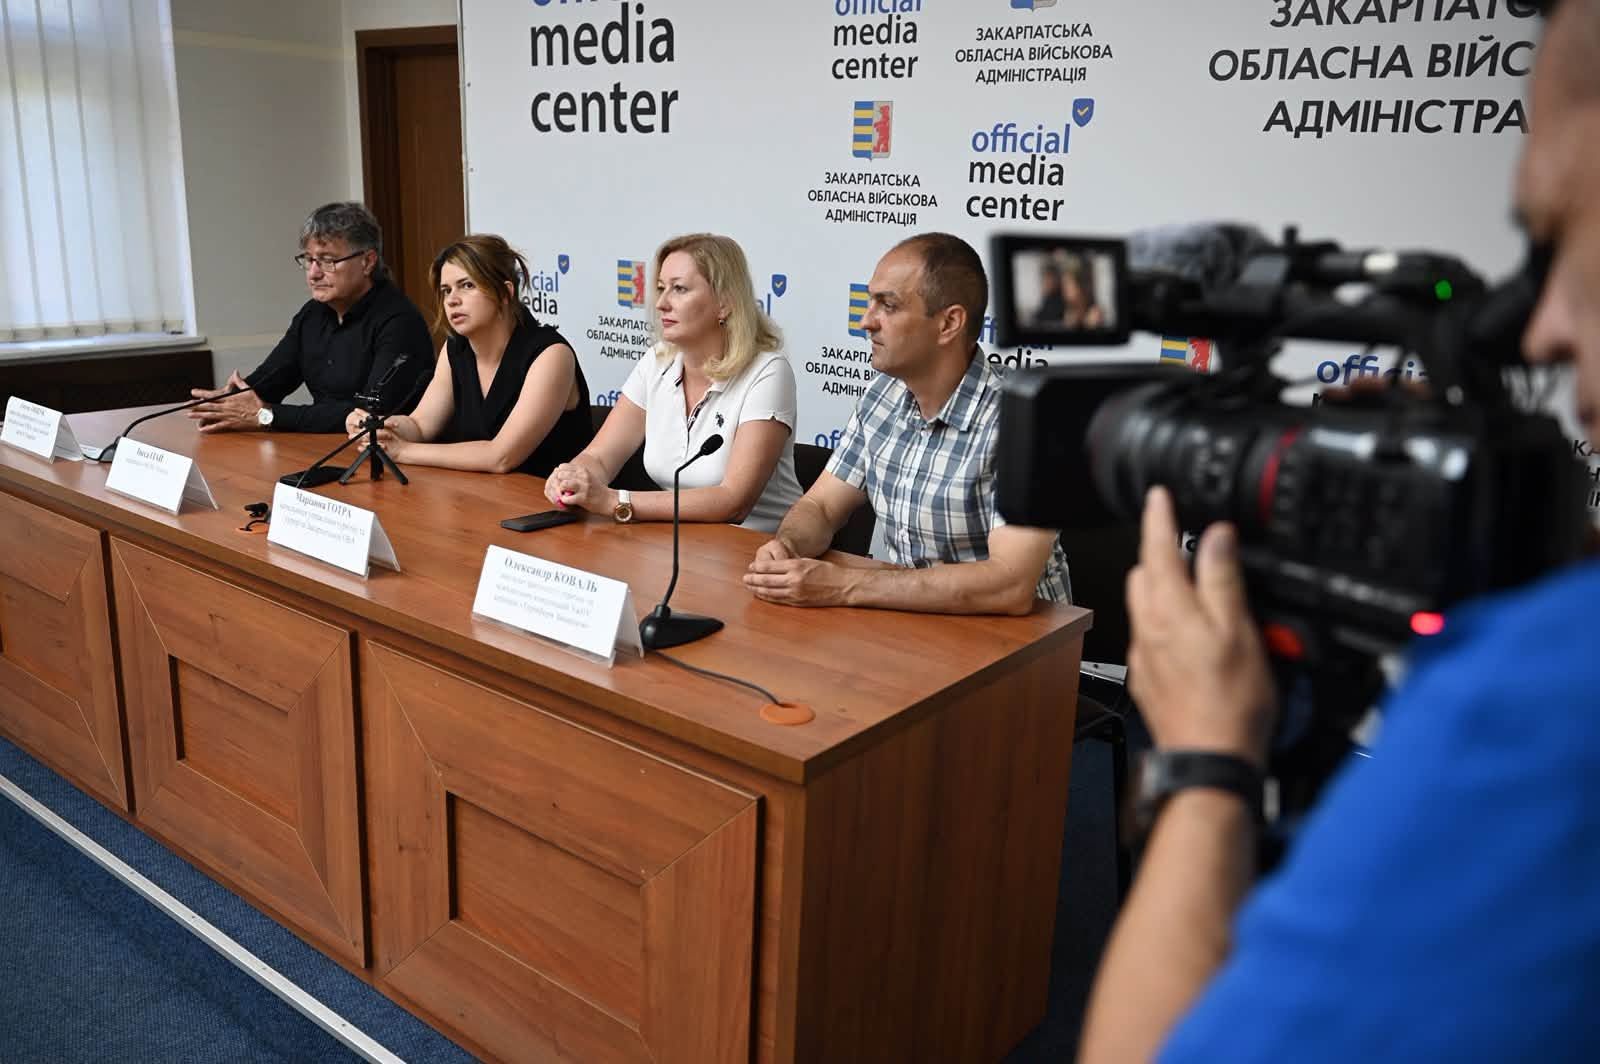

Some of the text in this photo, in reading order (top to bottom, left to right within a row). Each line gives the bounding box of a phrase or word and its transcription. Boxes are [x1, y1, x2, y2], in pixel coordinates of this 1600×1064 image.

[1269, 0, 1537, 28] ЗАКАРПАТ
[530, 2, 675, 66] media
[833, 14, 918, 46] media
[976, 23, 1092, 41] ЗАКАРПАТСЬКА
[955, 44, 1112, 62] ОБЛАСНА ВІЙСЬКОВА
[1209, 45, 1413, 81] ОБЛАСНА
[832, 53, 918, 79] center
[976, 67, 1086, 85] АДМІНІСТРАЦІЯ
[531, 82, 678, 133] center
[1261, 98, 1530, 140] АДМІНІСТРА
[971, 122, 1071, 154] official
[825, 172, 920, 187] ЗАКАРПАТСЬКА
[968, 155, 1065, 186] media
[808, 190, 937, 207] ОБЛАСНА ВІЙСЬКОВА
[967, 194, 1064, 221] center
[825, 209, 916, 227] АДМІНІСТРАЦІЯ
[531, 270, 559, 292] cial
[522, 291, 558, 315] edia
[598, 315, 648, 332] ЗАКАРПАТ
[586, 329, 630, 345] ОБЛАСНА
[600, 346, 647, 361] АДМІНІСТ
[821, 346, 873, 364] ЗАКАРПА
[987, 347, 1049, 370] edia
[805, 361, 861, 380] ОБЛАСНА
[504, 557, 598, 593] Олександр КОВАЛЬ
